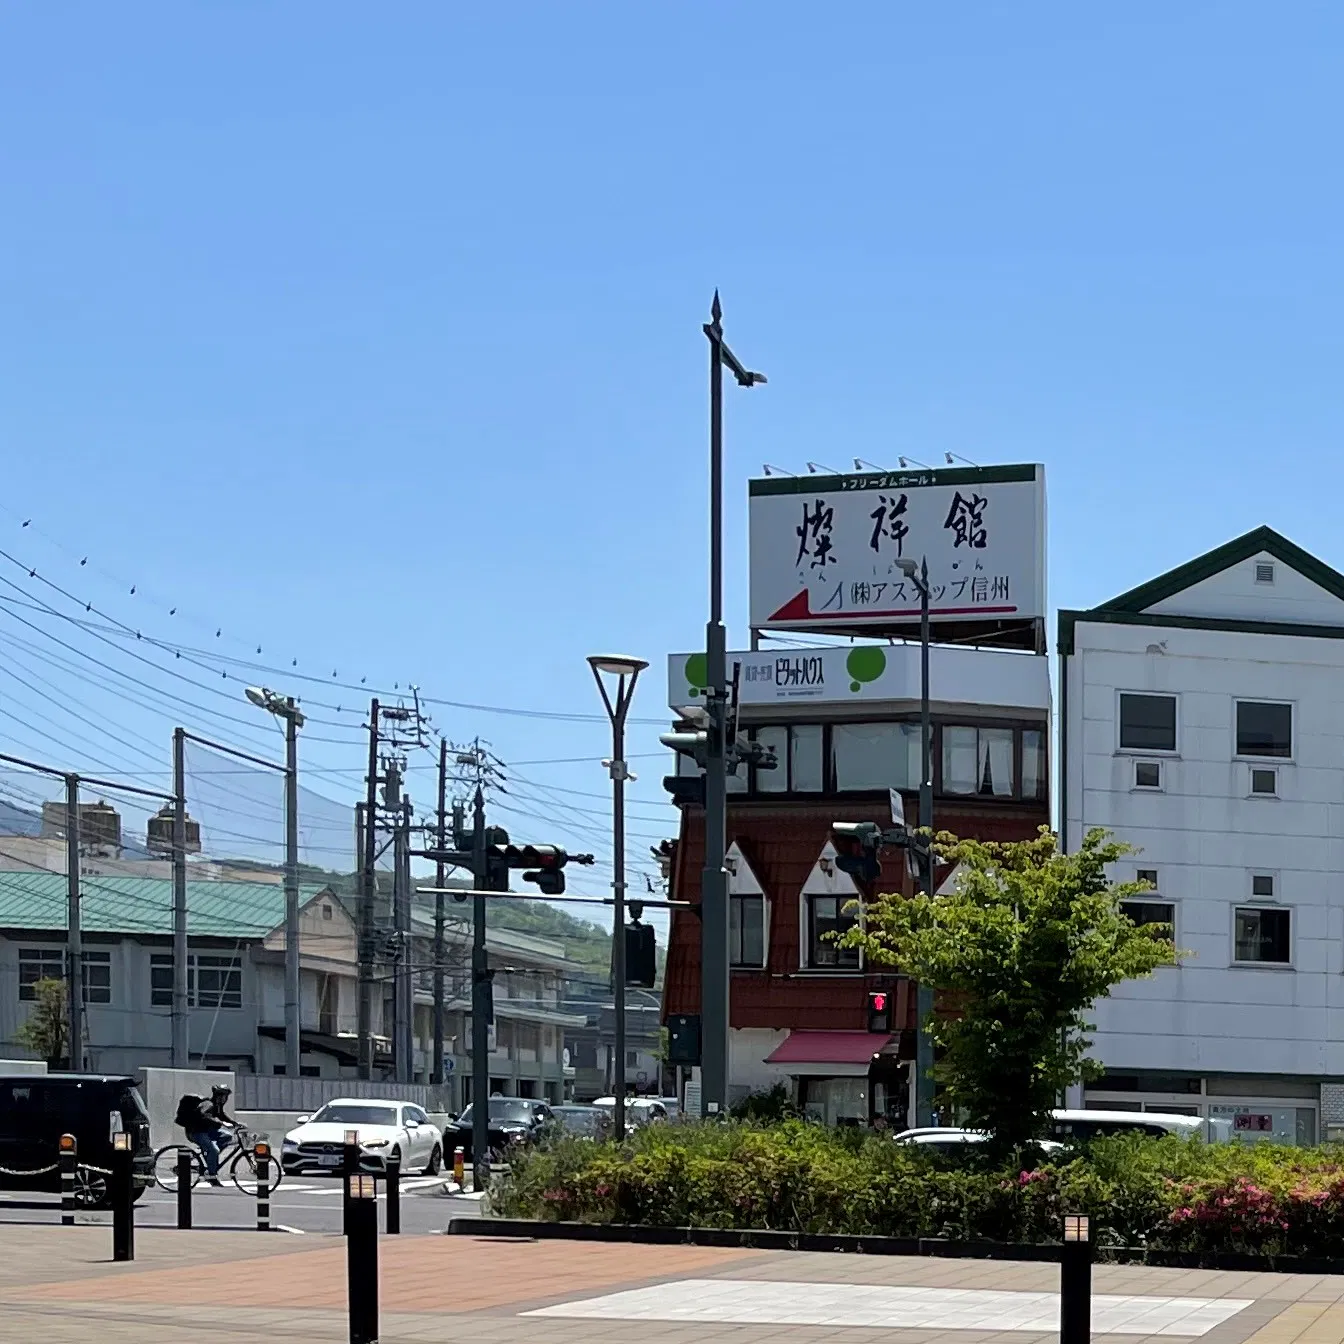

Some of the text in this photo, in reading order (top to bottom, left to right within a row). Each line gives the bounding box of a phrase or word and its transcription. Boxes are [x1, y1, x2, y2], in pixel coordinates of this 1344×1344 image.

[775, 657, 825, 686] ピタットハウス
